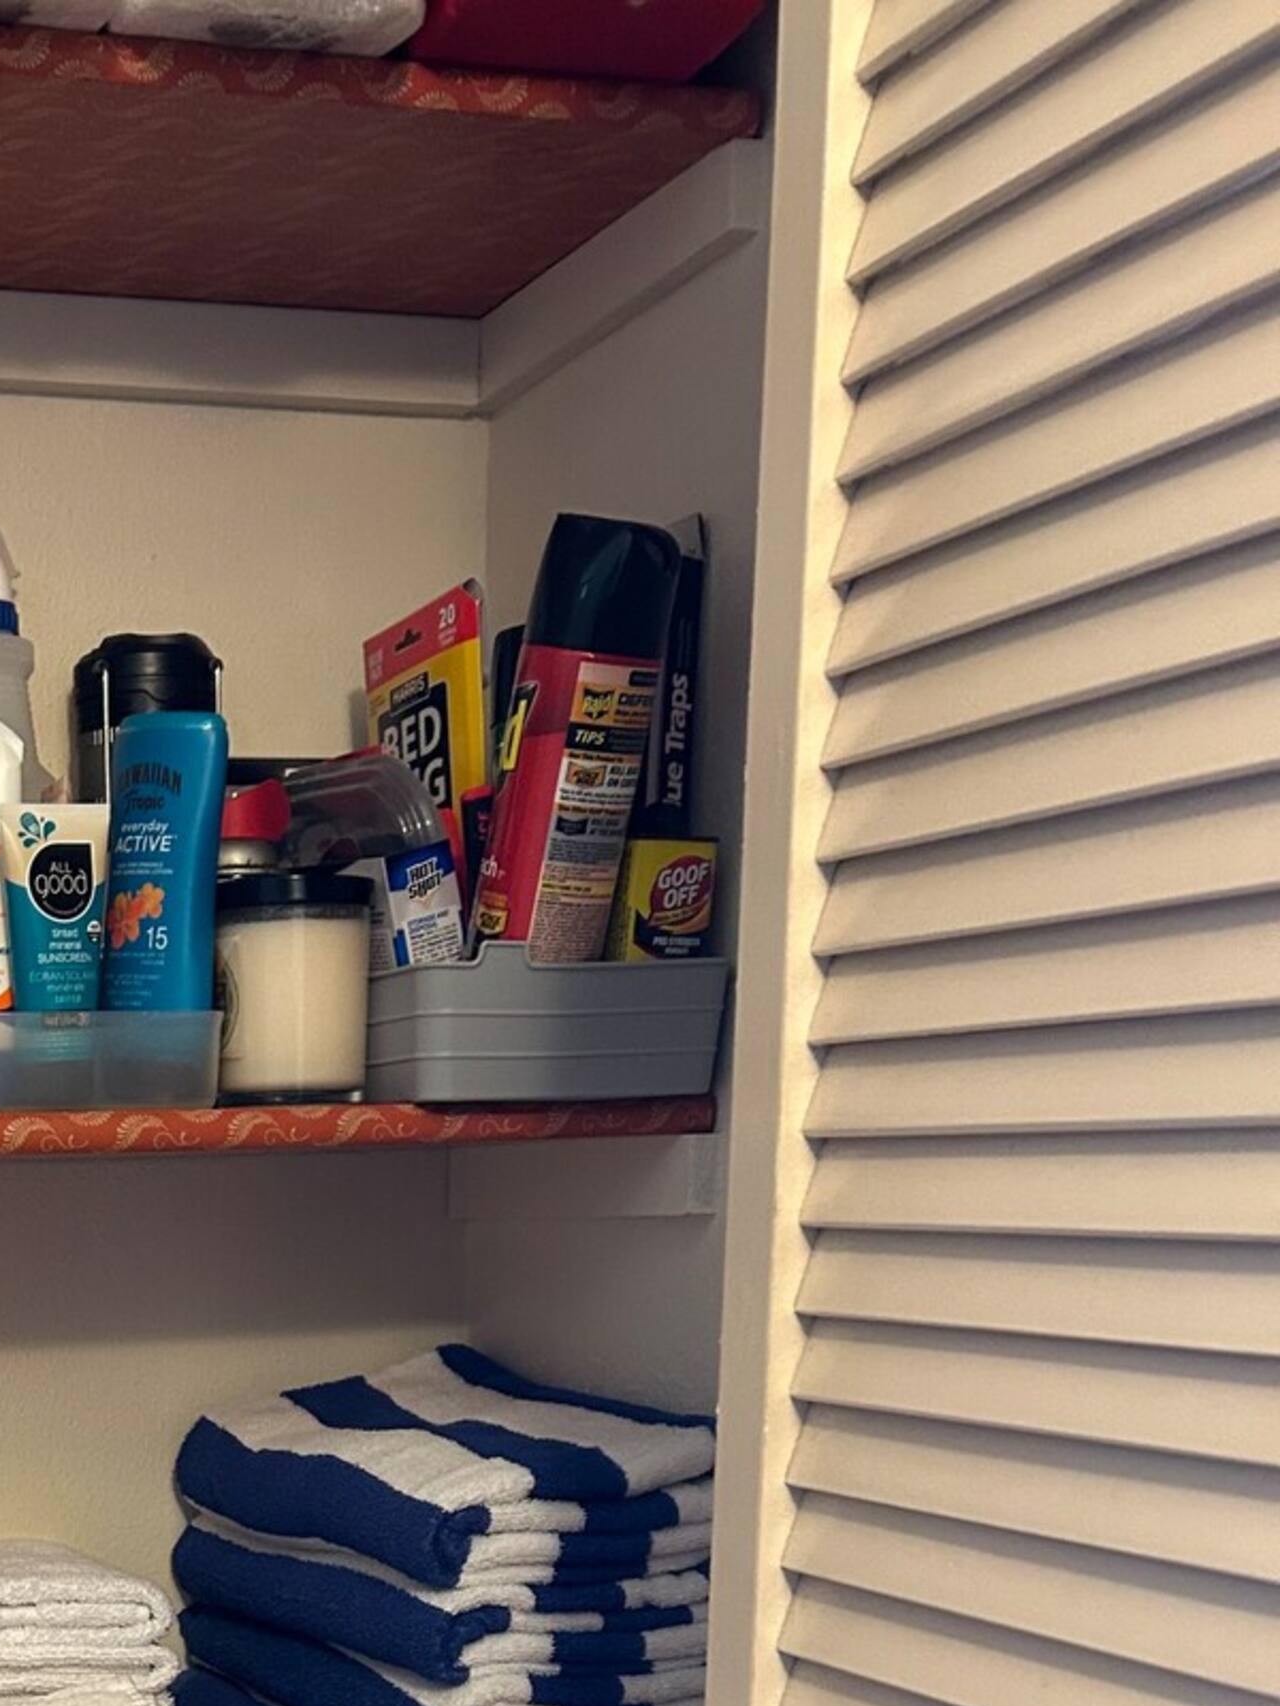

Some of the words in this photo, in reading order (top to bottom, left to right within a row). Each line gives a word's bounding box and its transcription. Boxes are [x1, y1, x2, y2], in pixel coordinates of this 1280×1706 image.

[438, 603, 456, 629] 20
[665, 673, 693, 754] Traps
[575, 728, 606, 745] TIPS
[662, 761, 685, 807] lue
[121, 819, 169, 835] everyday
[115, 835, 172, 853] ACTIVE
[49, 861, 72, 873] ALL
[409, 860, 436, 881] HOT
[658, 862, 710, 889] GOOF
[35, 867, 89, 898] good
[408, 872, 442, 899] SHOT
[663, 885, 699, 909] OFF
[146, 925, 168, 950] 15
